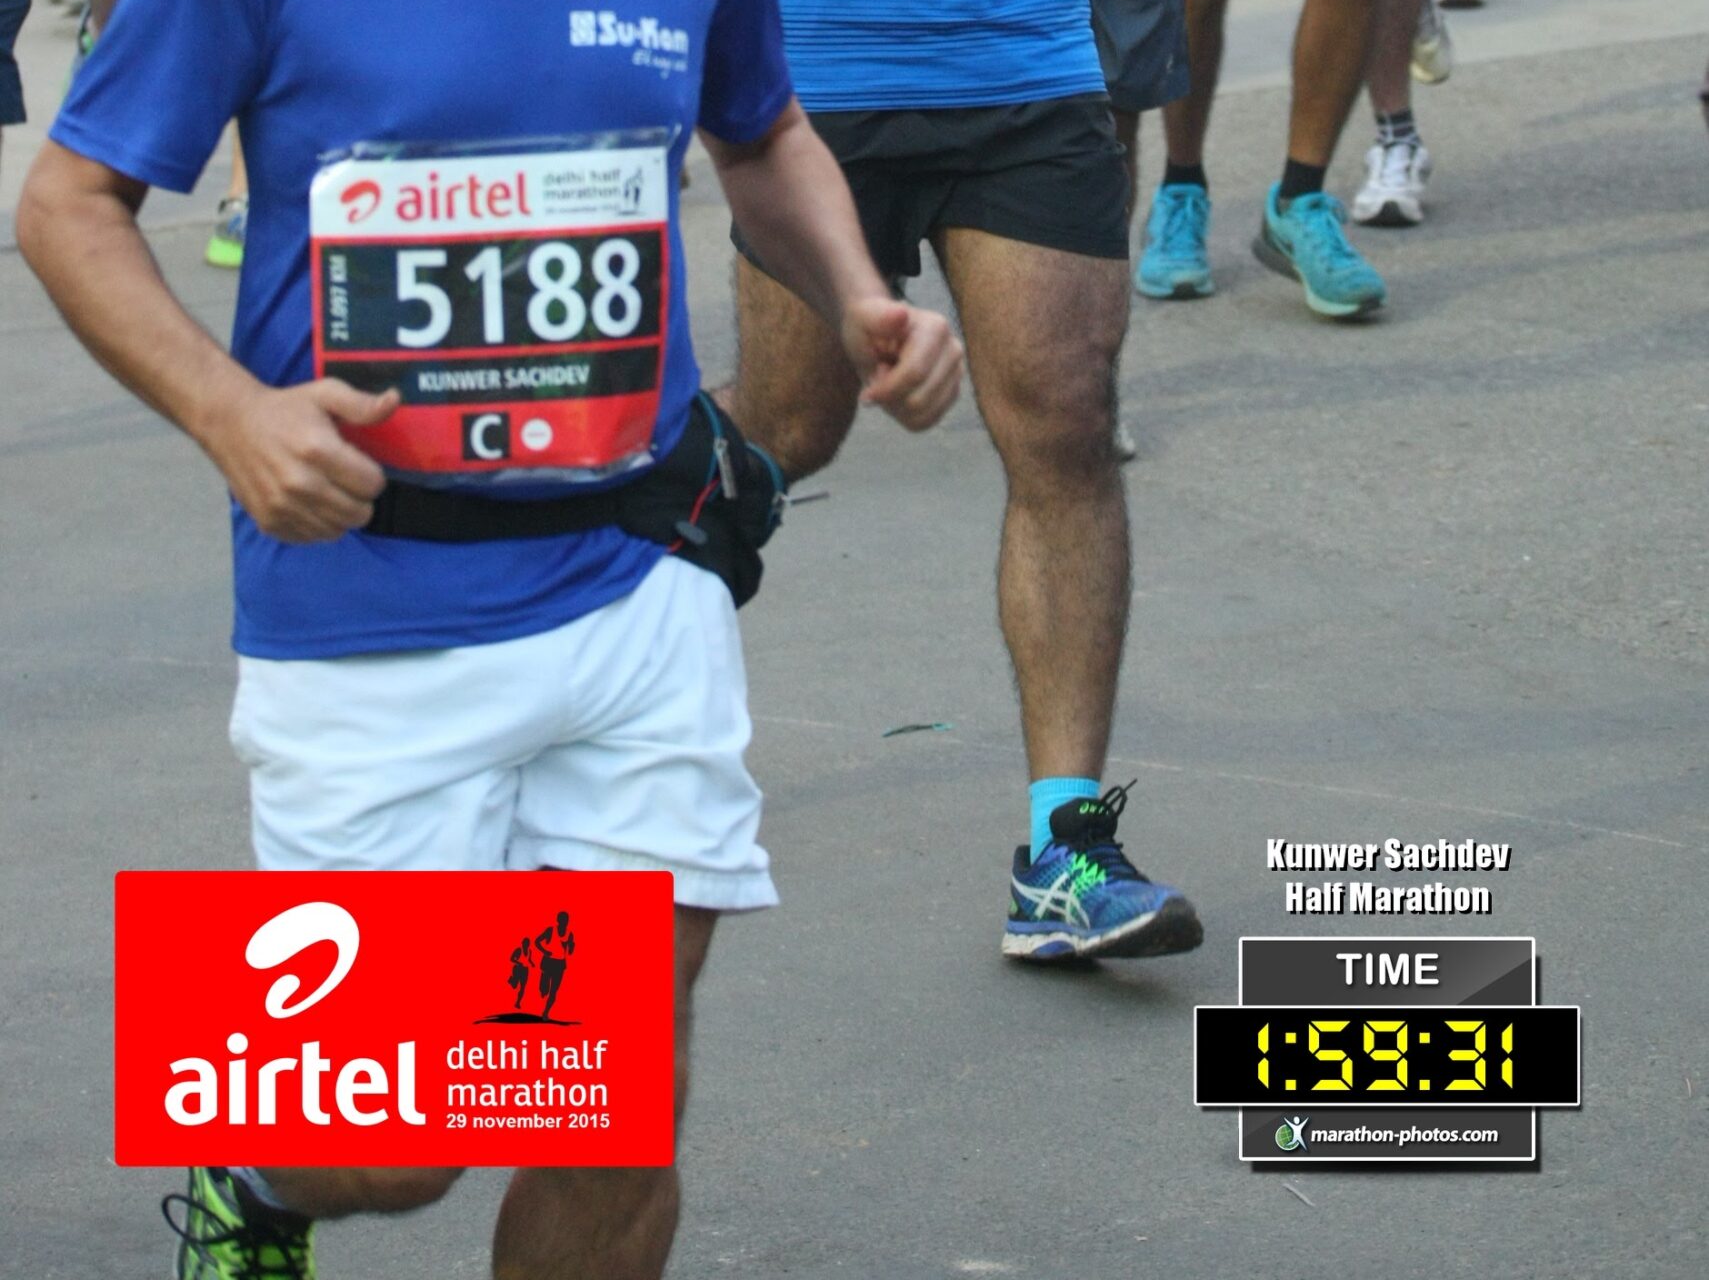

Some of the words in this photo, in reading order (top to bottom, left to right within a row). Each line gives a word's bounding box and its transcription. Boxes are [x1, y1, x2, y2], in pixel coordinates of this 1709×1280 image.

[396, 172, 531, 221] airtel
[397, 238, 642, 347] 5188
[418, 370, 500, 391] KUNWER
[504, 365, 590, 388] SACHDEV
[470, 413, 503, 459] C
